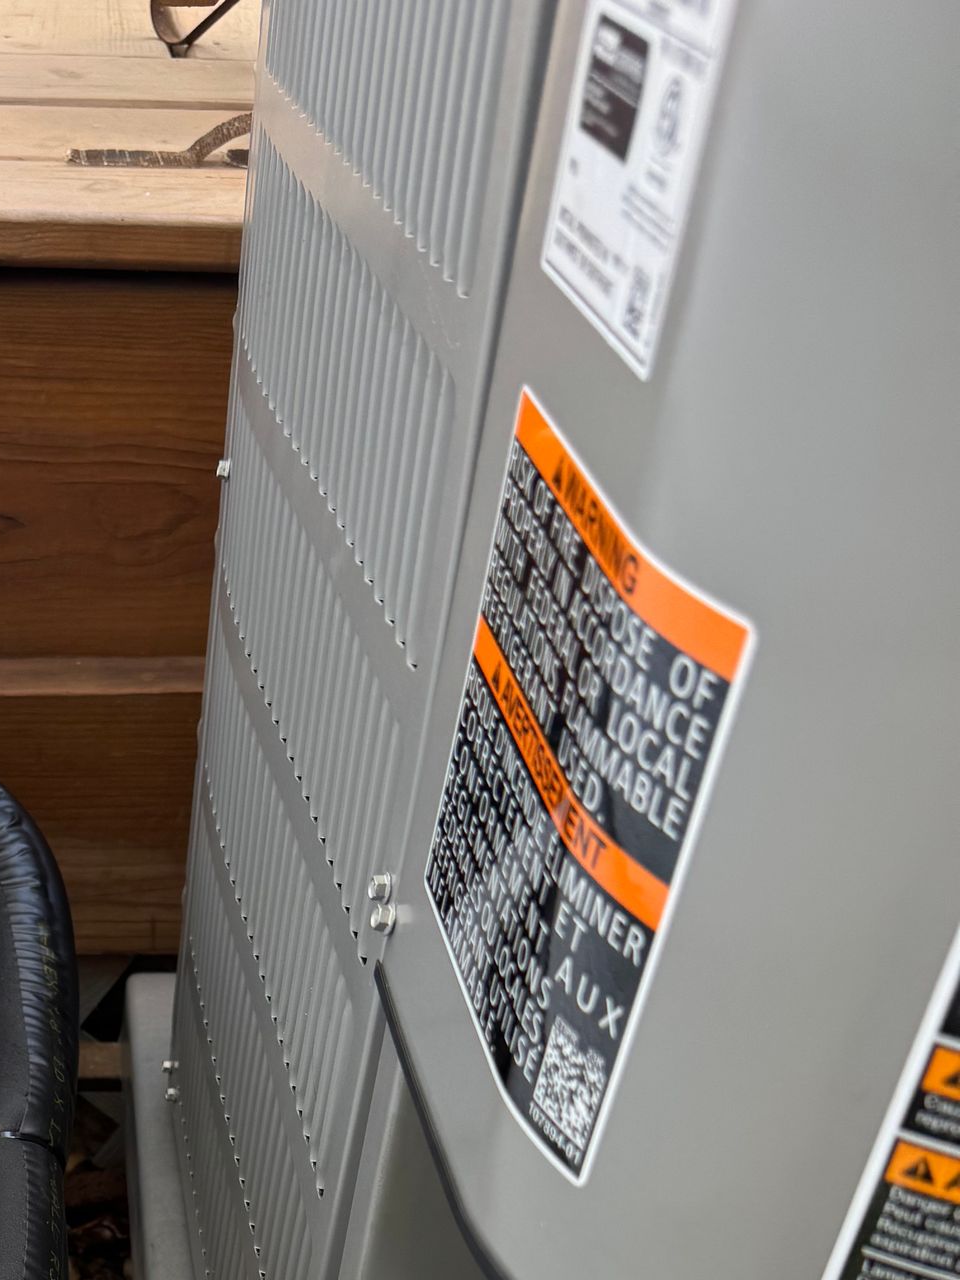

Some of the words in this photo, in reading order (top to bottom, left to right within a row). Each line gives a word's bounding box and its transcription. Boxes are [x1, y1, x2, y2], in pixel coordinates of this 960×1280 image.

[503, 478, 559, 584] PROPERLY
[552, 560, 574, 609] IN
[568, 591, 711, 760] ACCORDANCE
[507, 441, 537, 501] RISK
[533, 479, 555, 519] OF
[580, 554, 657, 671] DISPOSE
[669, 654, 719, 709] OF
[563, 468, 638, 595] WARNING
[467, 663, 498, 741] RISQUE
[481, 582, 557, 736] REFRIGERANT
[558, 728, 605, 824] USED.
[496, 517, 527, 583] WITH
[527, 568, 580, 679] FEDERAL
[577, 660, 602, 715] OR
[606, 701, 692, 801] LOCAL
[460, 698, 552, 905] CORRECTEMENT
[554, 901, 589, 952] ET
[560, 682, 686, 841] FLAMMABLE
[480, 901, 499, 946] OU
[554, 955, 625, 1040] AUX
